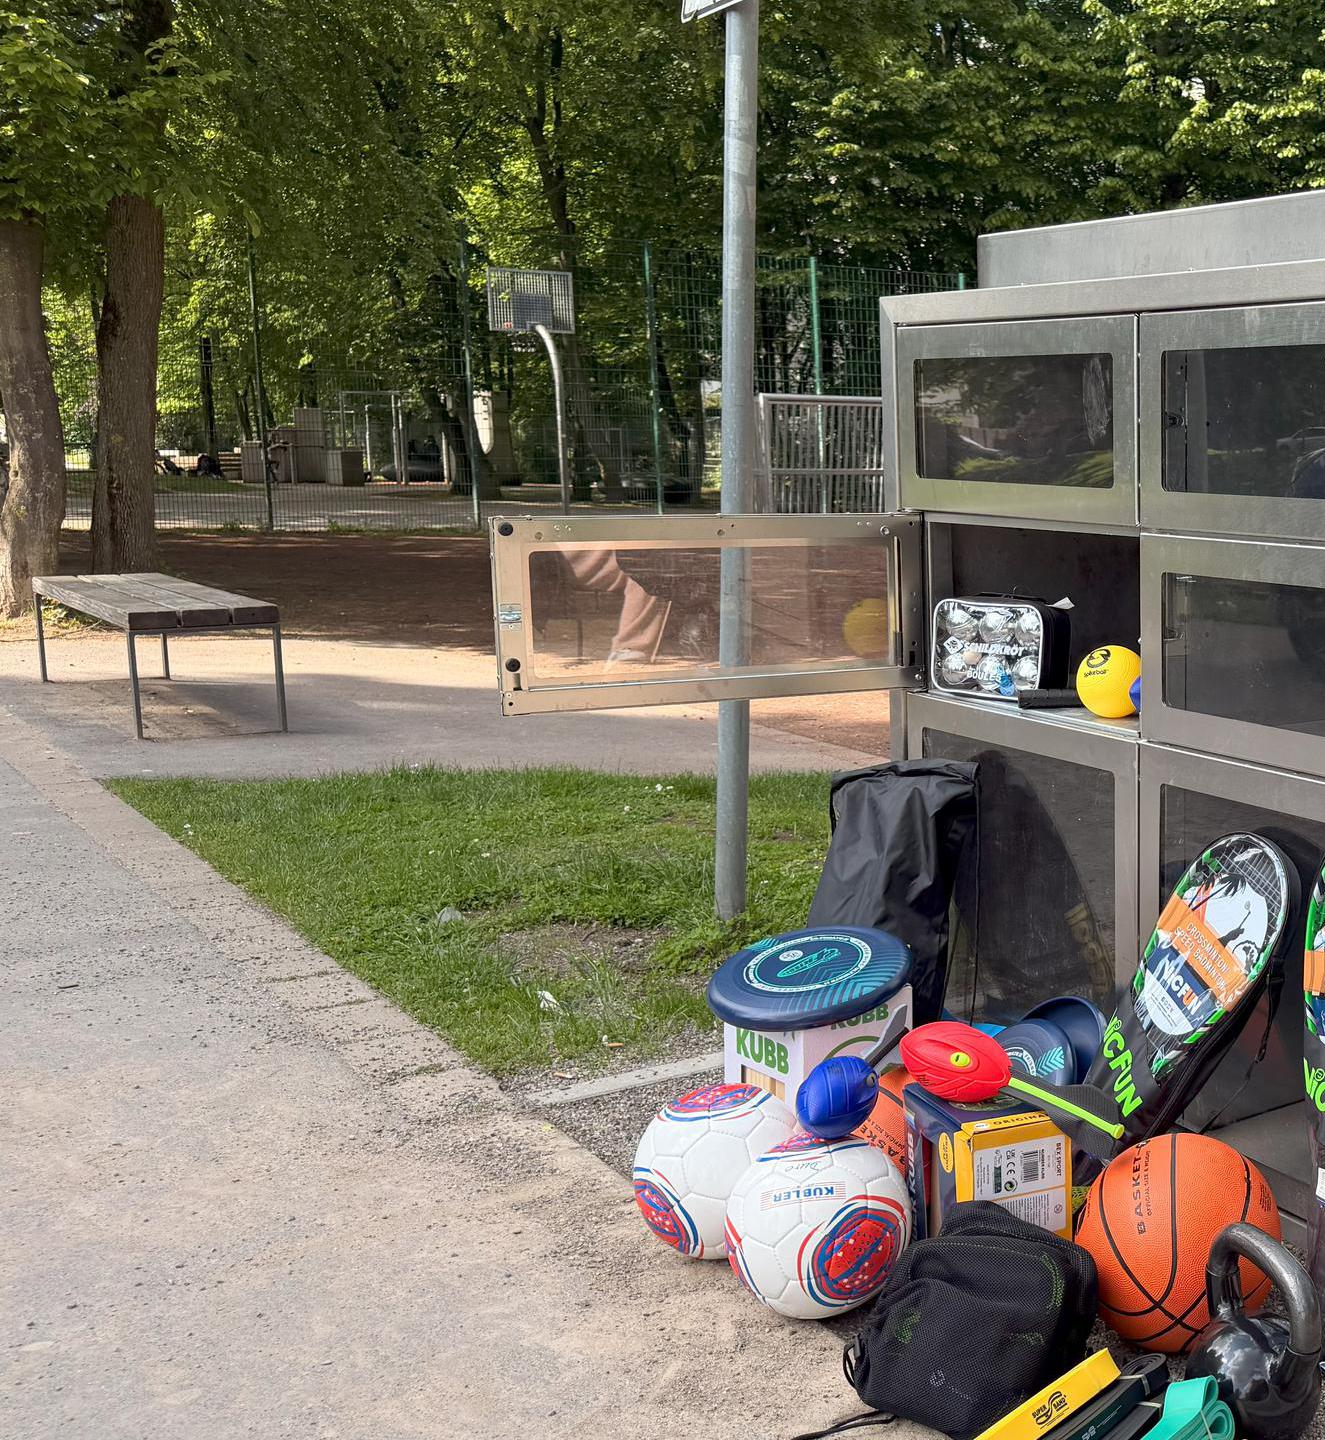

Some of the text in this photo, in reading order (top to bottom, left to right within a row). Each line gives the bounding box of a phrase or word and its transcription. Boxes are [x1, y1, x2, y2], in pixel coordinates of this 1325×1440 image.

[735, 1027, 790, 1075] KUBB
[993, 1114, 1046, 1125] ORIGINA
[907, 1132, 916, 1194] KUBB
[1031, 1404, 1048, 1419] SUPER
[1052, 1397, 1067, 1409] BAND
